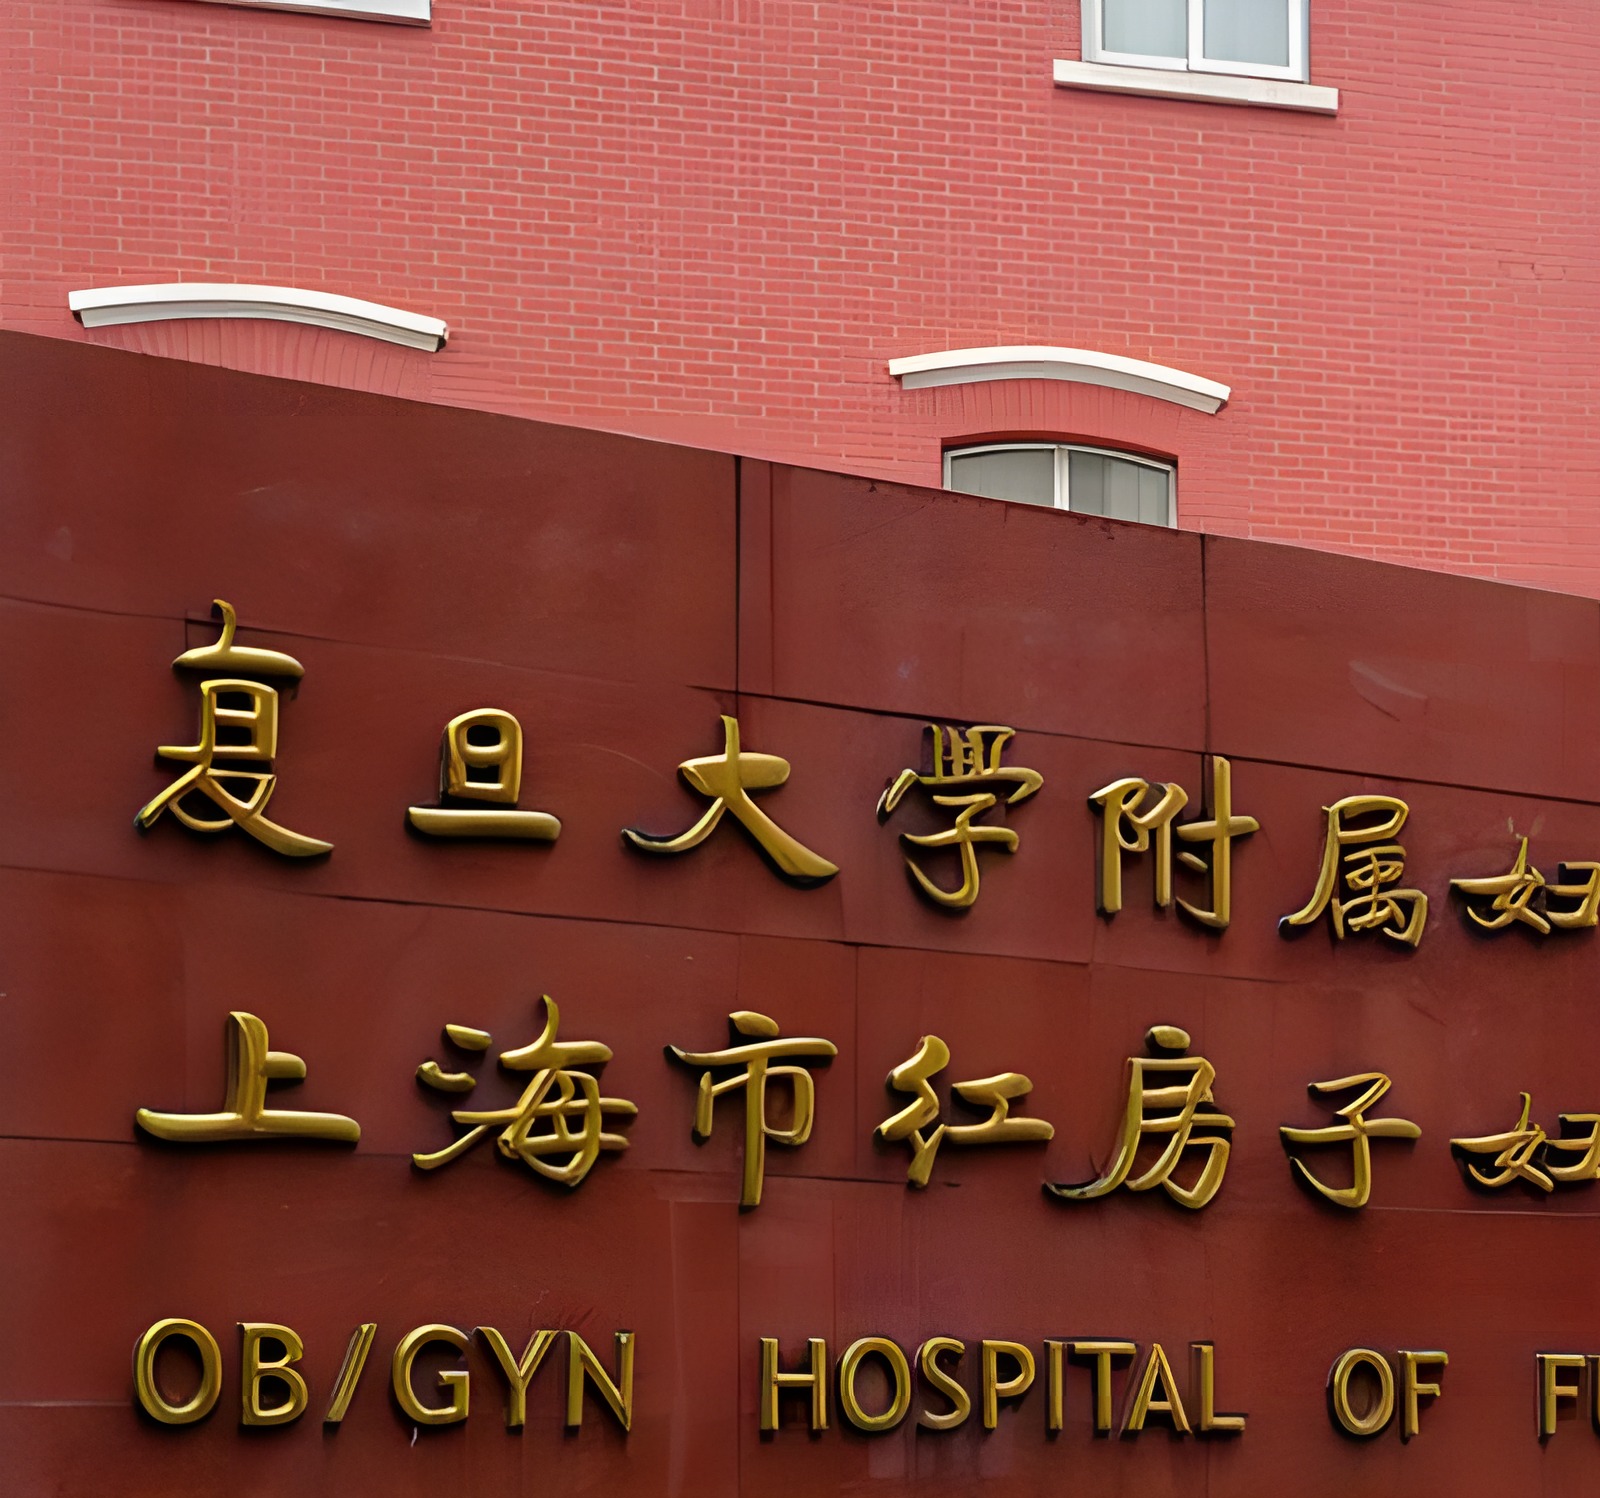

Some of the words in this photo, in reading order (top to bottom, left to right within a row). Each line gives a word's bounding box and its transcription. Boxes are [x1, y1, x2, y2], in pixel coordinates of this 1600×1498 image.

[136, 1318, 635, 1431] OB/GYN
[761, 1337, 1245, 1435] HOSPITAL
[1332, 1349, 1449, 1436] OF
